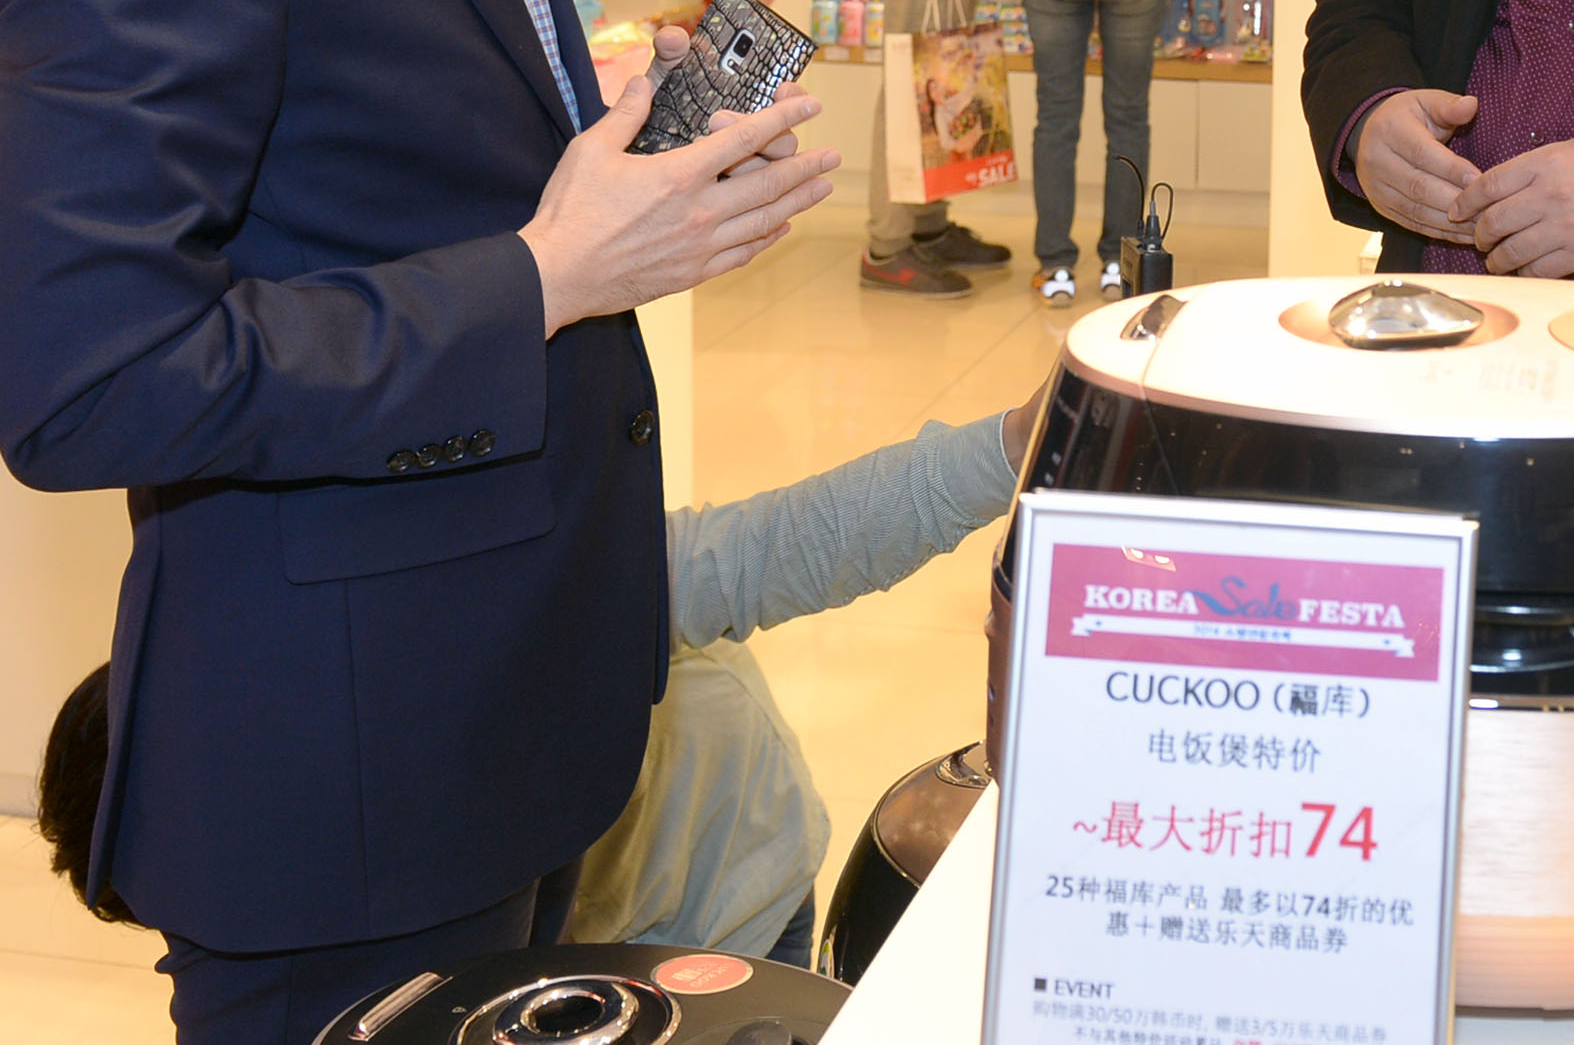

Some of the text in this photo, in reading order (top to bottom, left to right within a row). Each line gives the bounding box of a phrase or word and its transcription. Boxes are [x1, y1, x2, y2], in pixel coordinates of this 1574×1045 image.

[1084, 584, 1199, 615] KOREA
[1297, 598, 1405, 628] FESTA
[1105, 671, 1260, 711] CUCKOO
[1148, 728, 1322, 774] 电饭煲特价
[1045, 874, 1415, 926] 25种福库产品 最多以74折的优
[1053, 978, 1116, 1000] EVENT
